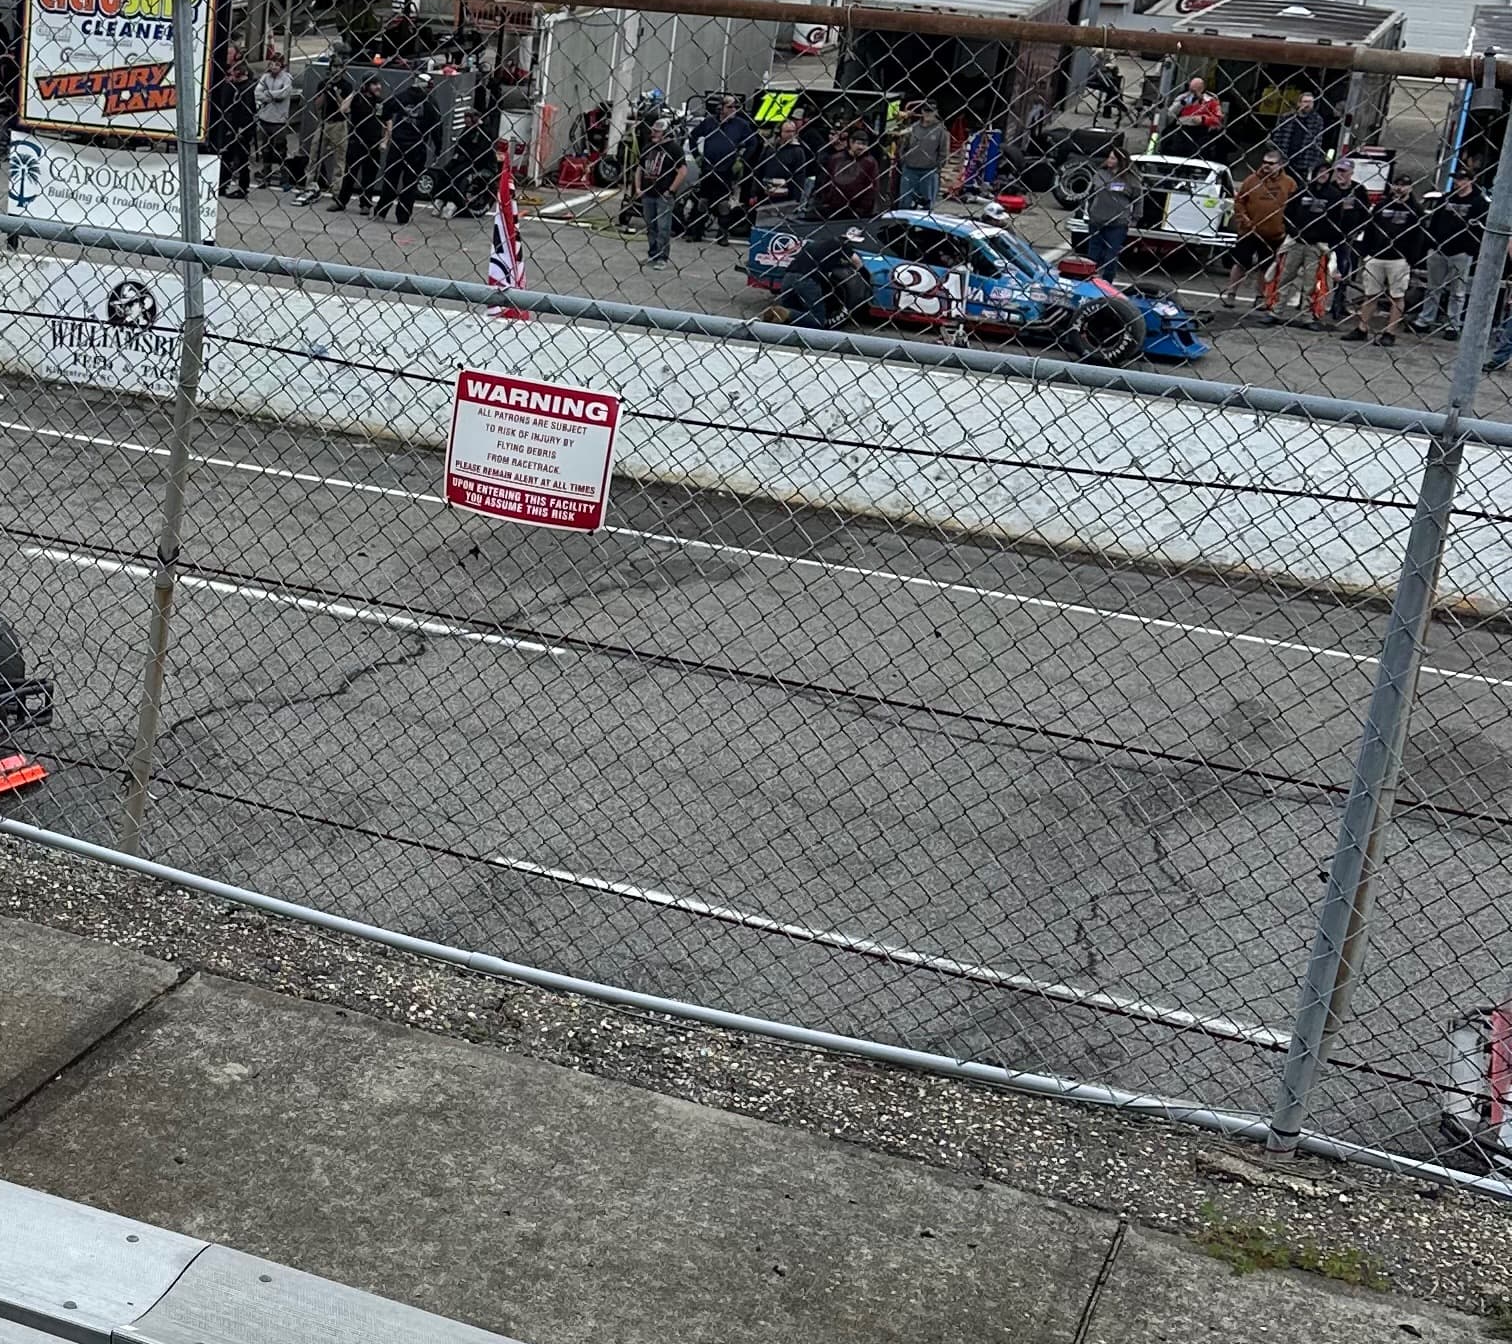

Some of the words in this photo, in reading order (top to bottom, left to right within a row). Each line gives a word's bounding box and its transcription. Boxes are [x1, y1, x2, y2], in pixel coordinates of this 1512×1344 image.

[37, 65, 167, 100] VICTORY
[467, 379, 609, 422] WARNING
[477, 407, 491, 418] ALL
[494, 410, 530, 425] PATRONS
[532, 418, 549, 429] ARE
[550, 421, 588, 436] SUBJECT
[485, 423, 496, 433] TO
[498, 425, 517, 437] RISK
[518, 429, 529, 439] OF
[531, 431, 561, 446] INJURY
[563, 436, 575, 448] BY
[486, 452, 510, 465] FROM
[511, 457, 561, 475] RACETRACK.
[496, 440, 524, 453] FLYING
[526, 445, 557, 460] DEBRIS
[455, 460, 481, 473] PLEASE
[483, 465, 512, 481] REMAIN
[514, 472, 538, 485] ALERT
[540, 477, 551, 488] AT
[553, 479, 567, 491] ALL
[570, 483, 596, 495] TIMES
[452, 477, 474, 491] UPON
[476, 482, 522, 503] ENTERING
[524, 493, 547, 507] THIS
[550, 498, 596, 514] FACILITY
[465, 491, 483, 504] YOU
[485, 496, 523, 513] ASSUME
[527, 505, 549, 517] THIS
[551, 509, 575, 522] RISK
